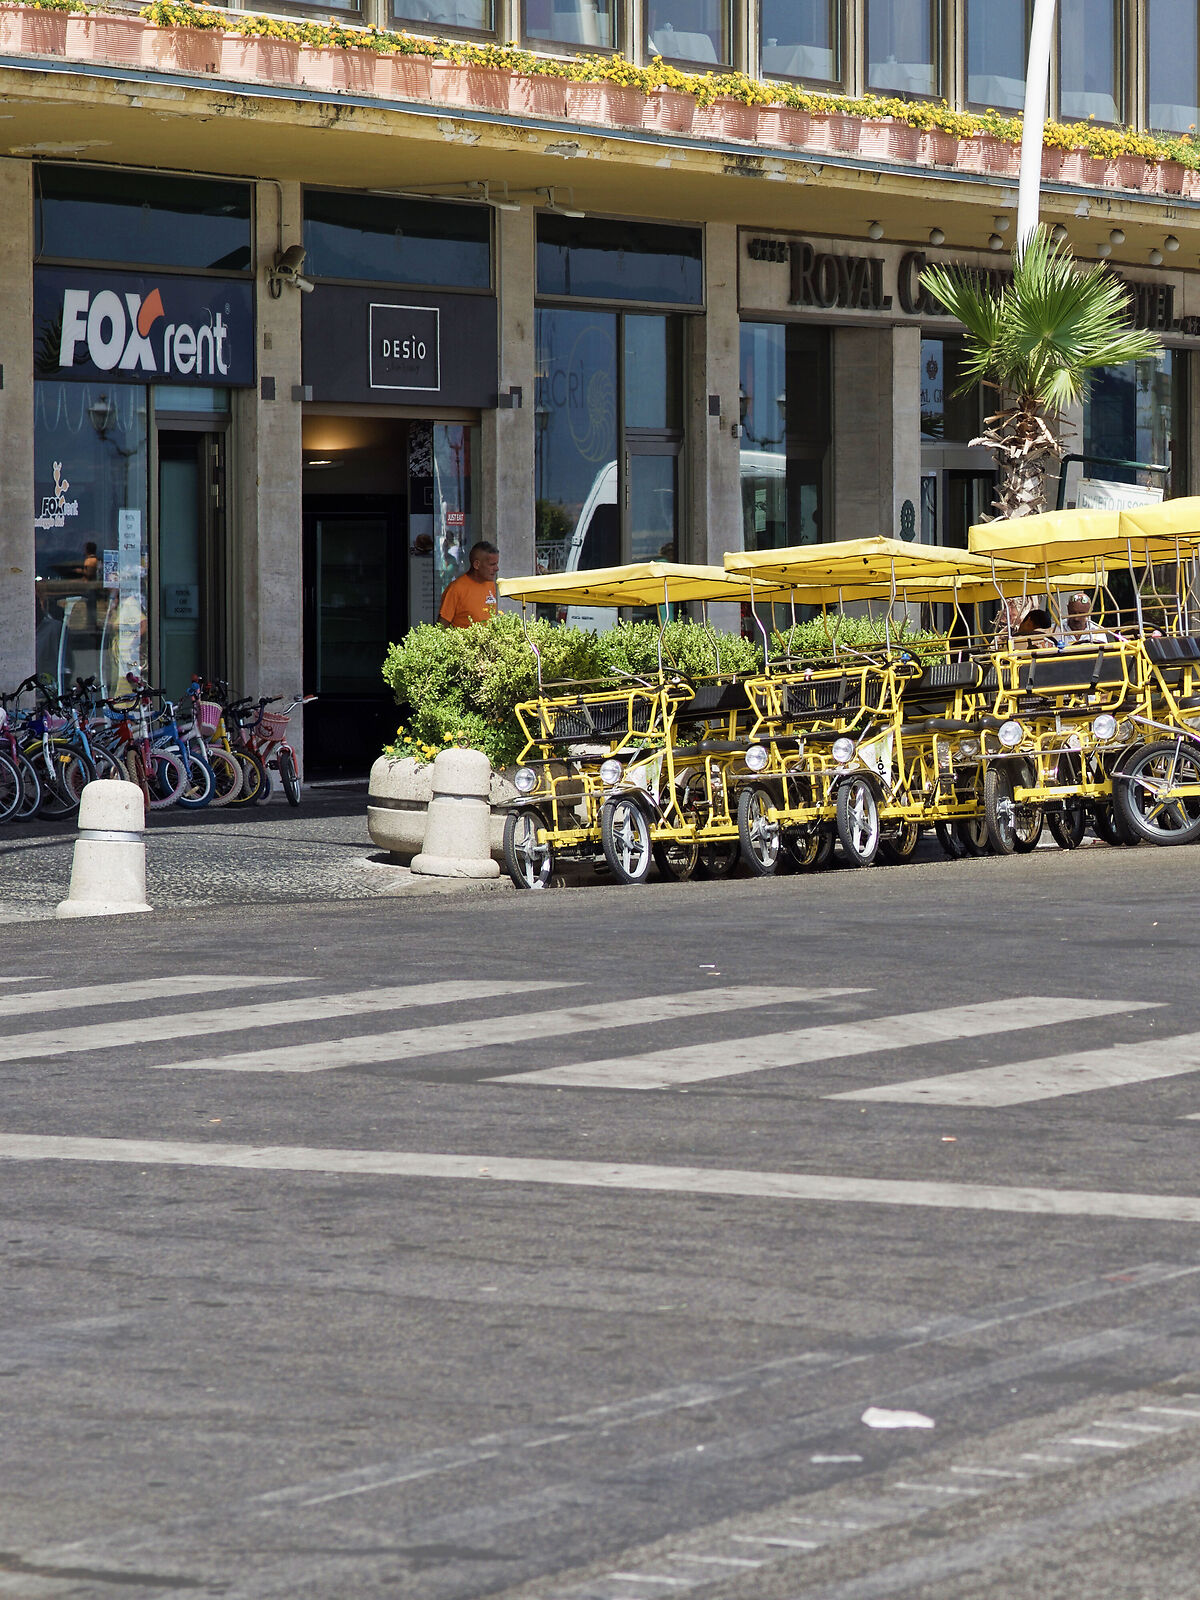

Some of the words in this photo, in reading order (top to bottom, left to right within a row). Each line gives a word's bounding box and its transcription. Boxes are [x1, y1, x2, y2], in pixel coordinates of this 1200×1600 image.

[788, 242, 893, 311] ROYAL
[58, 288, 164, 371] FOX
[163, 312, 228, 375] rent
[42, 496, 64, 516] FOX
[876, 756, 887, 775] FOX
